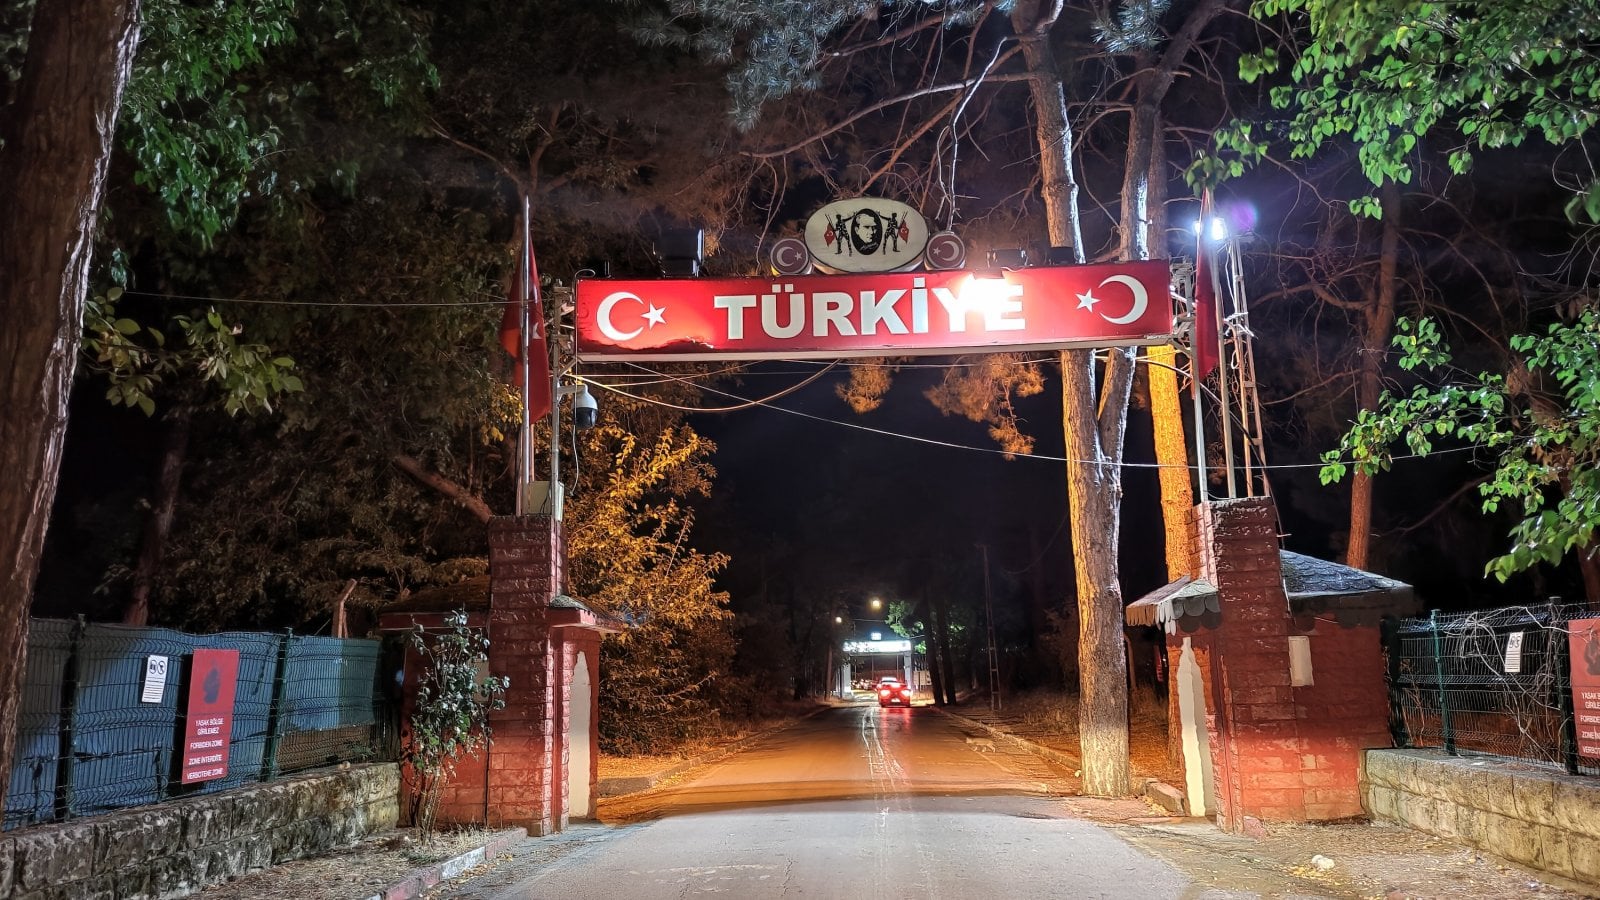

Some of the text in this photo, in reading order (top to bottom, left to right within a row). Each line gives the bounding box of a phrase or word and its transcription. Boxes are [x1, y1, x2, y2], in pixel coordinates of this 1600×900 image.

[713, 277, 1025, 339] TÜRKİYE
[196, 718, 224, 727] YASAK BÖLGE
[211, 739, 223, 747] ZONE
[188, 758, 201, 766] ZONE
[211, 767, 224, 775] ZONE
